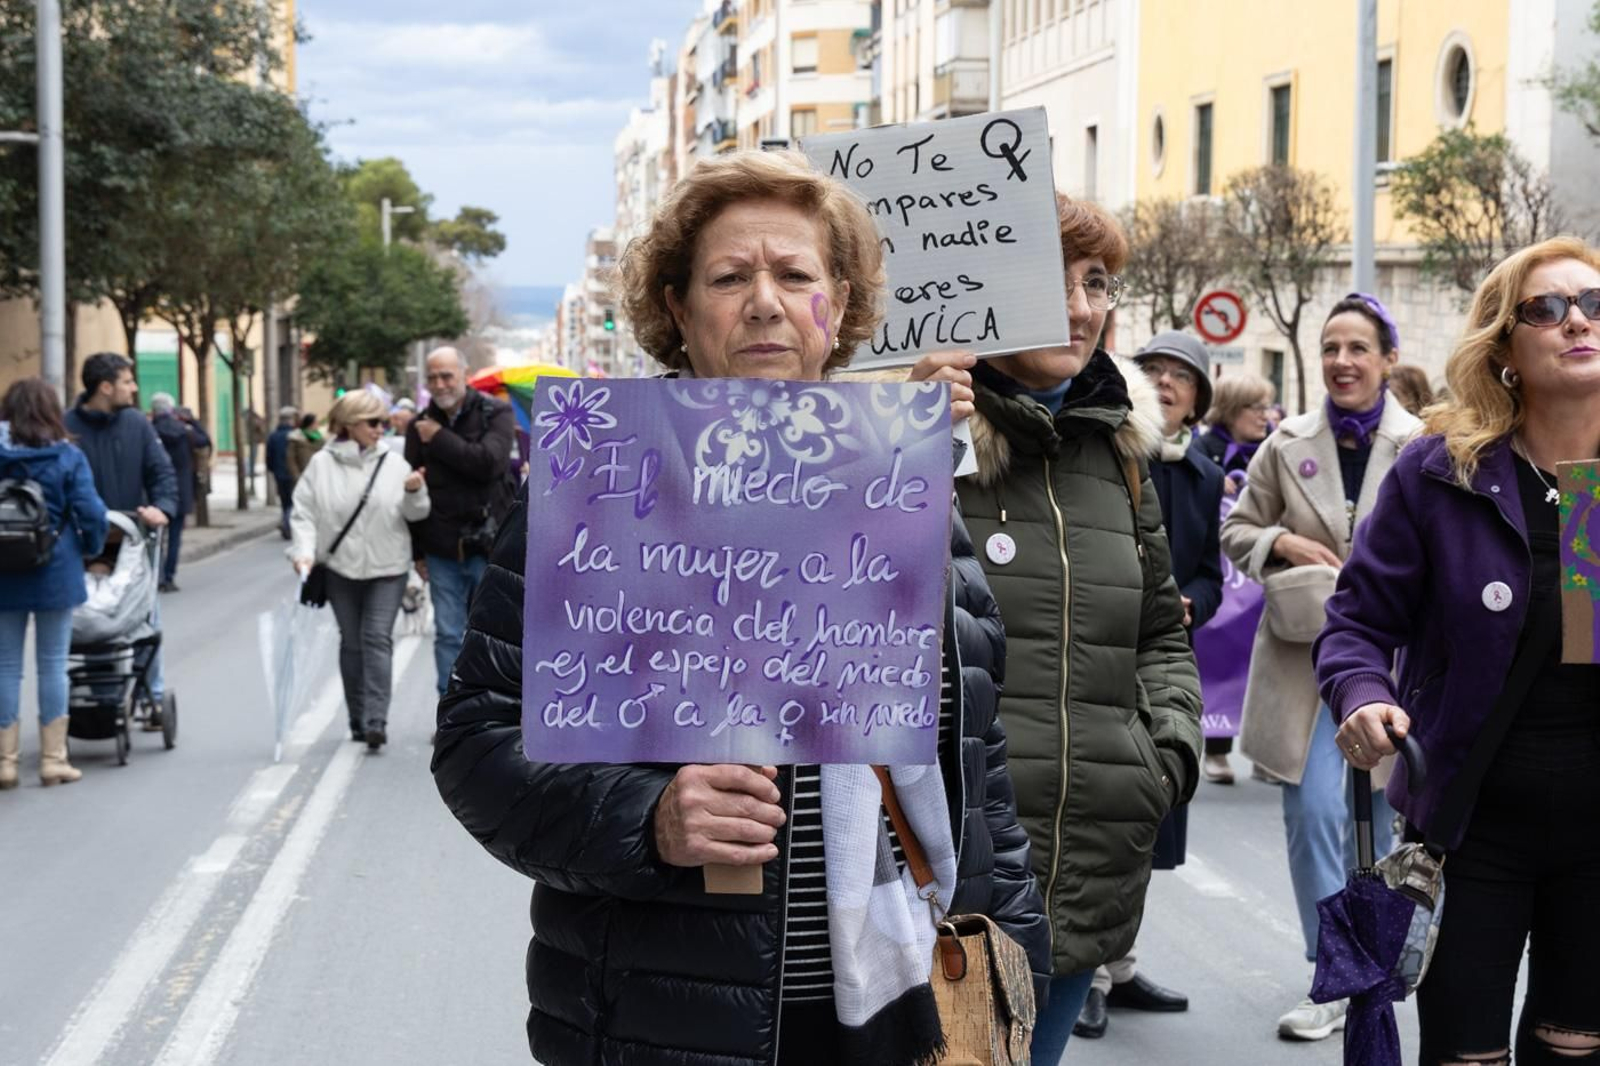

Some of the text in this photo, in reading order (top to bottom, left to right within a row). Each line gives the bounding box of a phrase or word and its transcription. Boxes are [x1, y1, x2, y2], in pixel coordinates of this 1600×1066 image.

[829, 134, 954, 179] No Te
[922, 220, 1017, 251] nadie
[895, 274, 984, 304] eres
[590, 435, 928, 517] El miedo de
[558, 524, 899, 605] la mujer a la
[565, 590, 936, 657] violencia del hombre
[596, 643, 635, 675] el
[648, 646, 747, 692] espejo
[763, 651, 827, 687] del
[837, 653, 931, 691] miedo
[543, 692, 935, 737] del a la sin miedo
